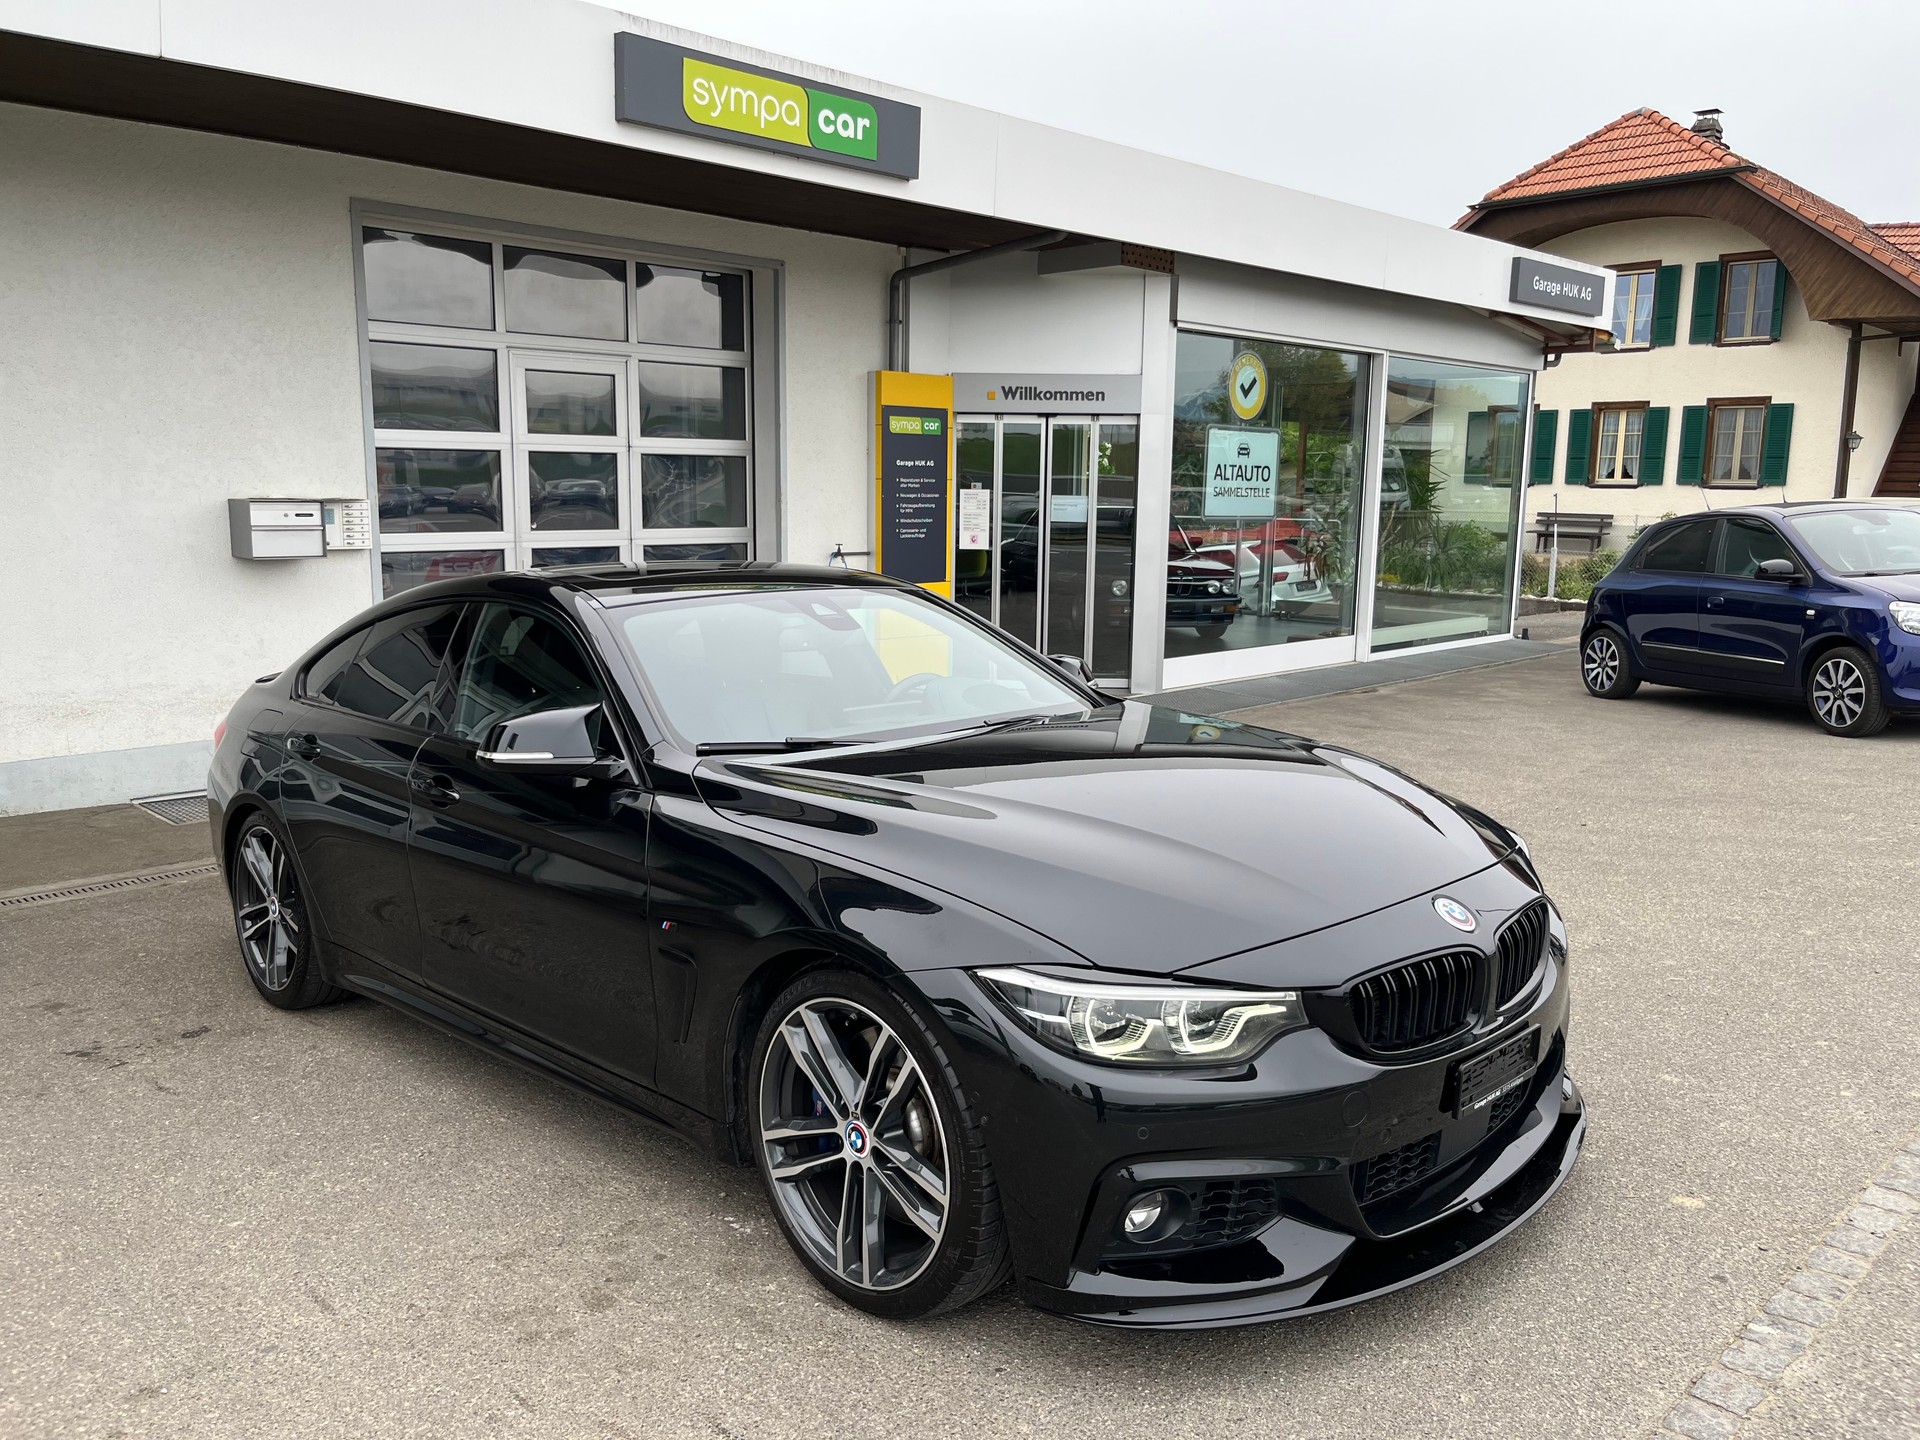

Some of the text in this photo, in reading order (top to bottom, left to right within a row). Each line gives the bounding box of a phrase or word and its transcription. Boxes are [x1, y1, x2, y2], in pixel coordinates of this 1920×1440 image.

[692, 77, 870, 141] sympa car
[1533, 275, 1592, 301] Garage HUK AG
[1000, 385, 1106, 402] Willkommen
[891, 420, 940, 432] sympa car
[1213, 464, 1271, 483] ALTAUTO
[1213, 486, 1271, 498] SAMMELSTELLE
